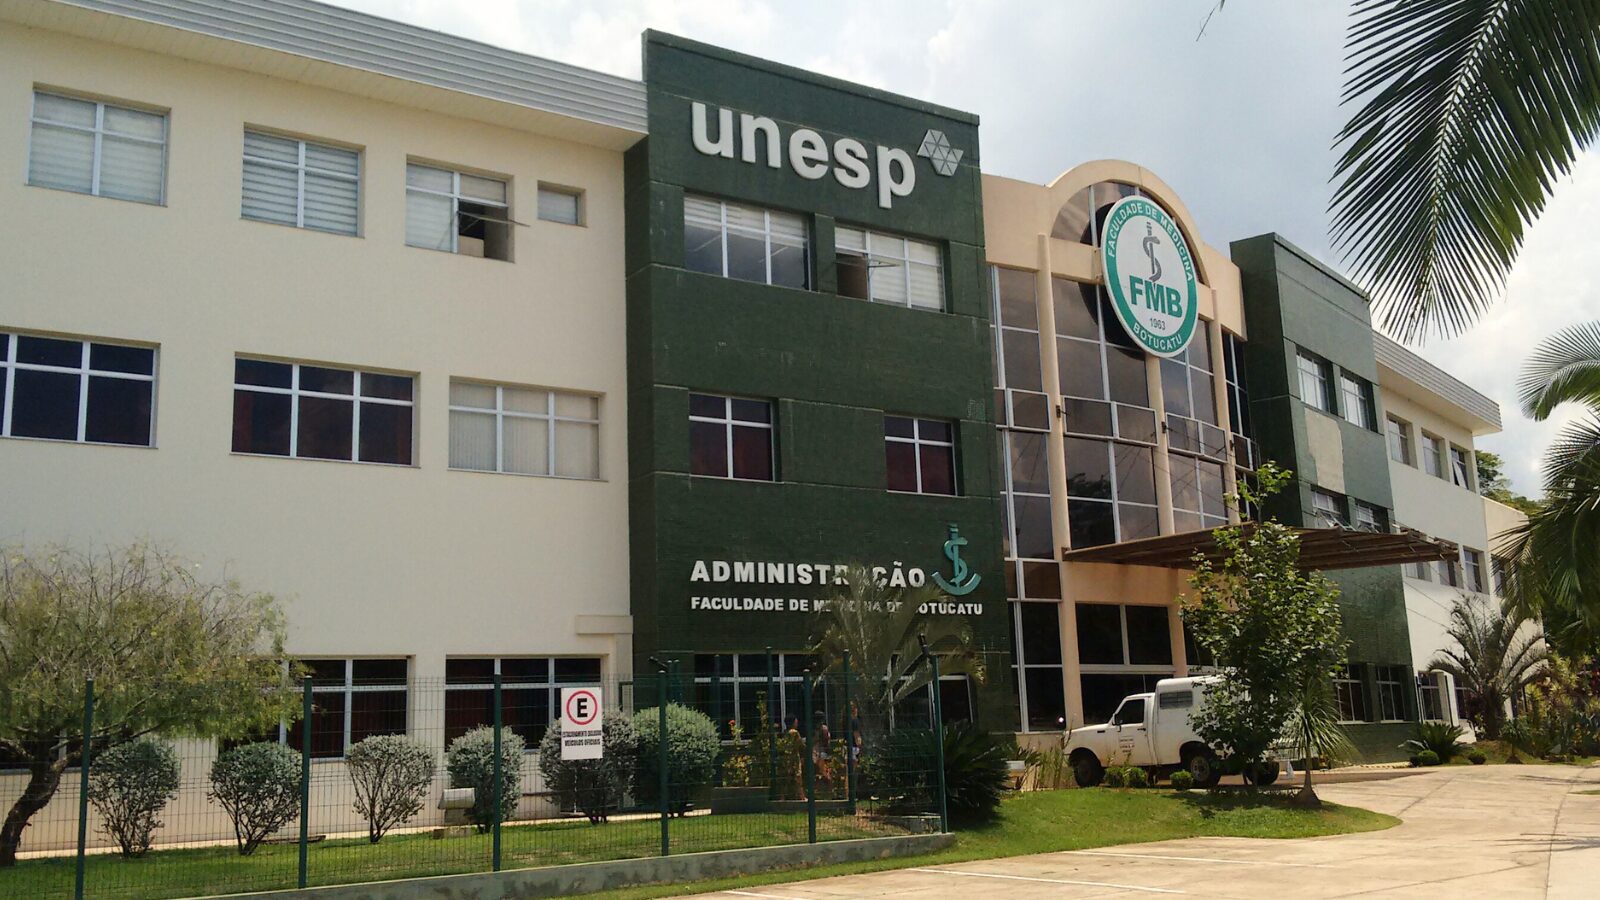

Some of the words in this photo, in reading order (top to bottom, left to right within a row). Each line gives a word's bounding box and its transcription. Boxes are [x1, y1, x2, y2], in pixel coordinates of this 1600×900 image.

[691, 101, 916, 209] unesp
[1107, 202, 1143, 257] FACULDADE
[1145, 204, 1158, 219] DE
[1159, 216, 1193, 281] MEDICINA
[1128, 274, 1183, 318] FMB
[1132, 323, 1183, 350] BOTUCATU
[1149, 317, 1166, 331] 1963
[690, 560, 926, 591] ADMINISTRÇÃO
[691, 596, 784, 611] FACULDADE
[788, 598, 809, 612] DE
[813, 599, 882, 612] MENA
[911, 602, 983, 615] OTUCATU
[577, 698, 588, 717] E
